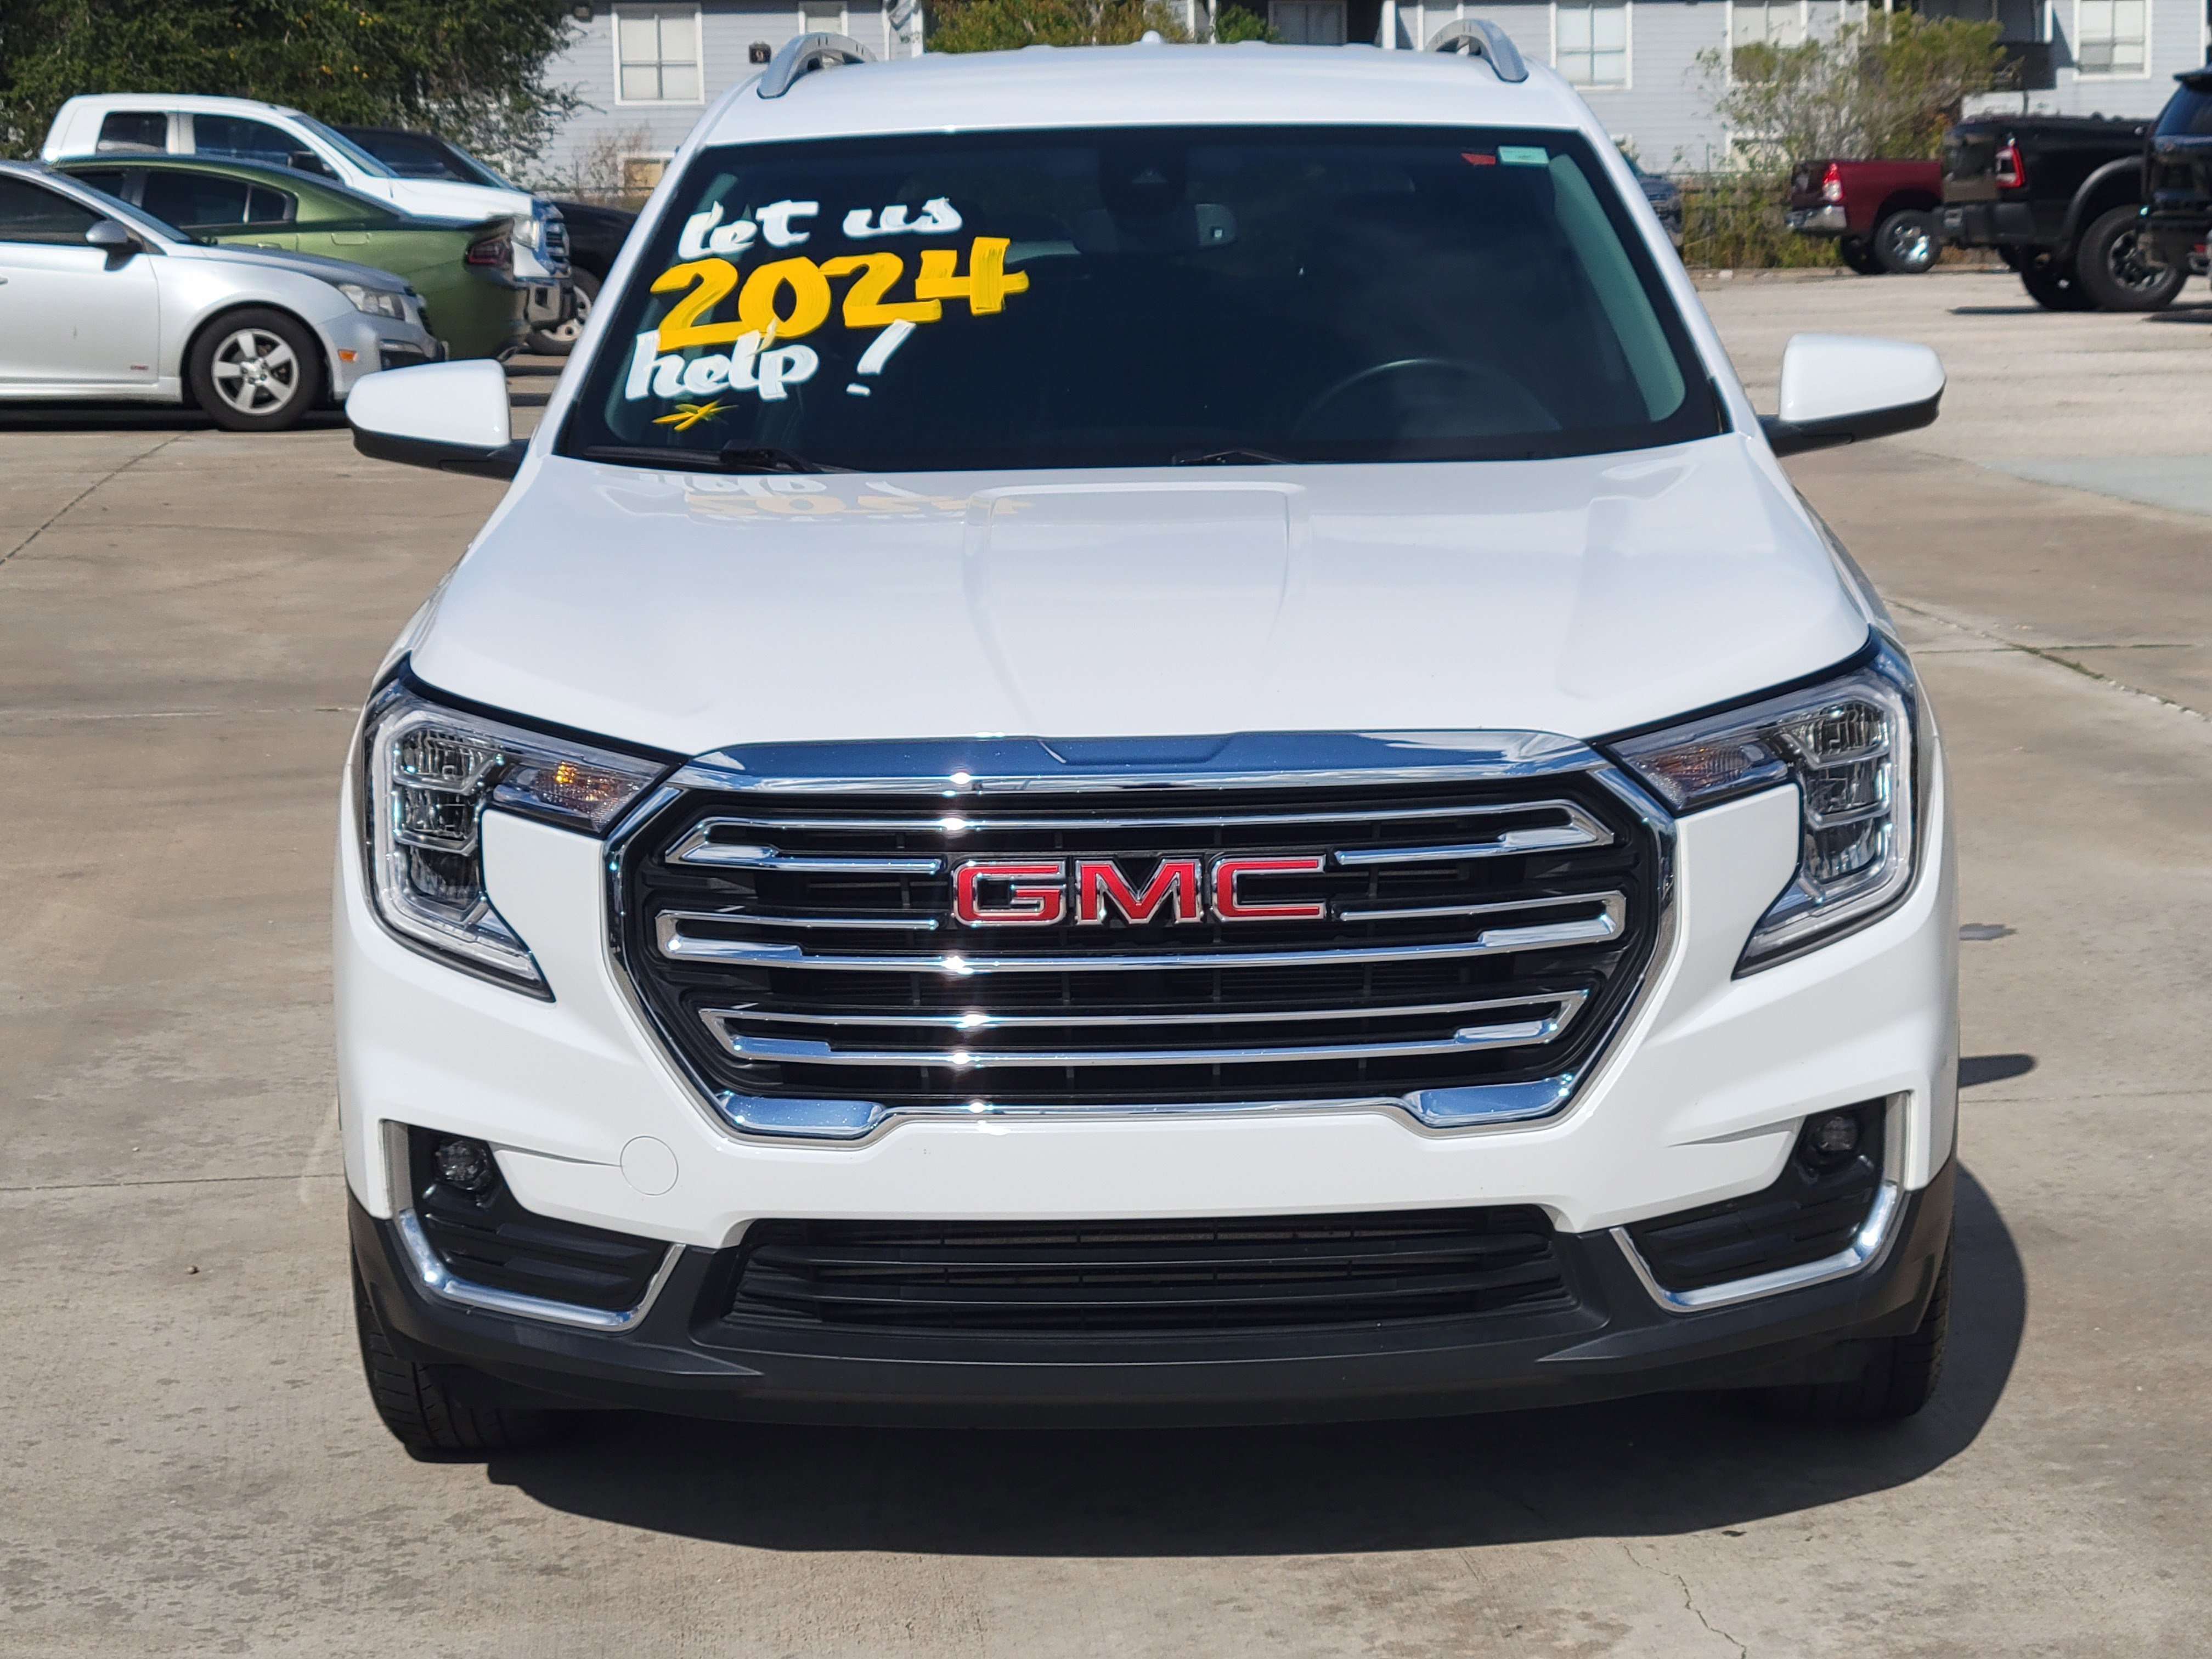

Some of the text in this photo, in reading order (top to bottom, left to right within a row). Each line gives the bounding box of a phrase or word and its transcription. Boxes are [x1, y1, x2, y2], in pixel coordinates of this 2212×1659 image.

[843, 198, 962, 238] us
[650, 237, 1029, 351] 2024
[952, 855, 1327, 926] GMC
